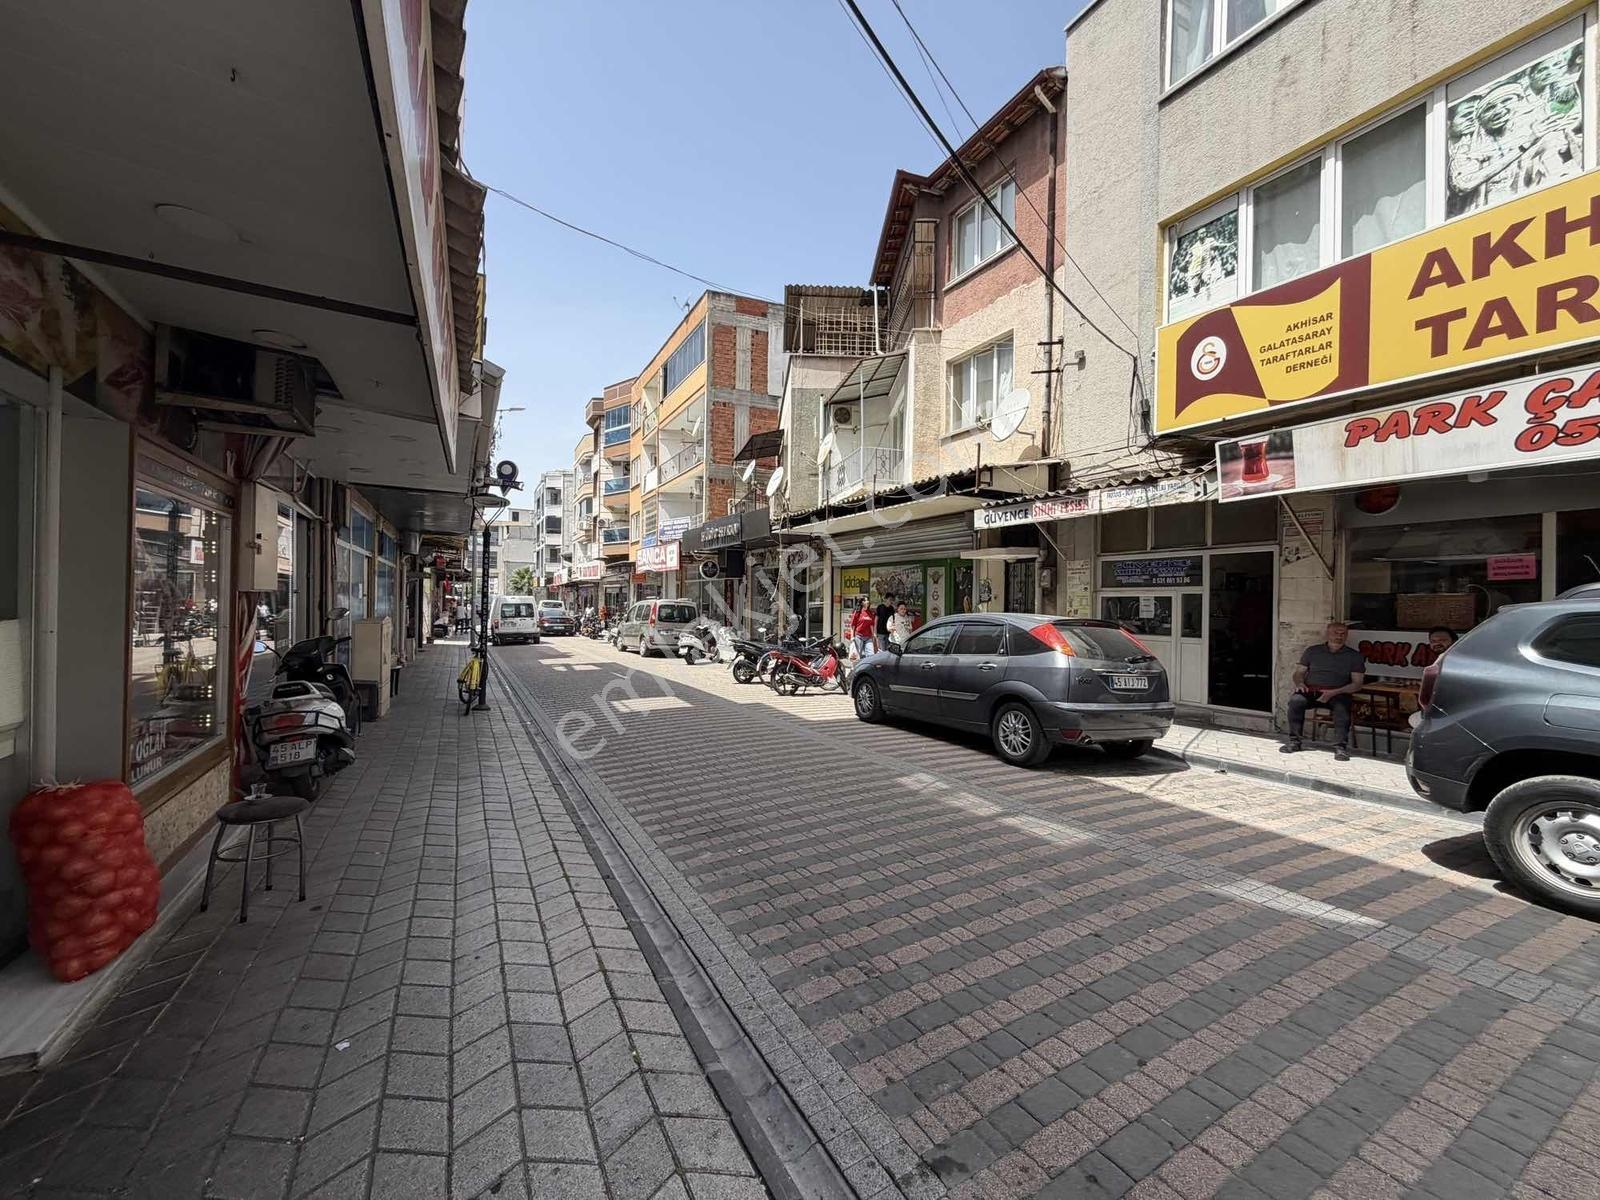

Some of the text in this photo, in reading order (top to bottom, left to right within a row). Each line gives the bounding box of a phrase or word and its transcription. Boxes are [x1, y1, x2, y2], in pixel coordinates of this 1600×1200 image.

[1407, 195, 1600, 300] AKH
[1285, 312, 1334, 333] AKHİSAR
[1414, 274, 1600, 359] TAR
[1259, 326, 1333, 354] GALATASARAY
[1259, 340, 1333, 367] TARAFTARLAR
[1285, 353, 1332, 374] DERNEĞİ
[1344, 390, 1507, 447] PARK
[983, 507, 1030, 525] GÜVENCE
